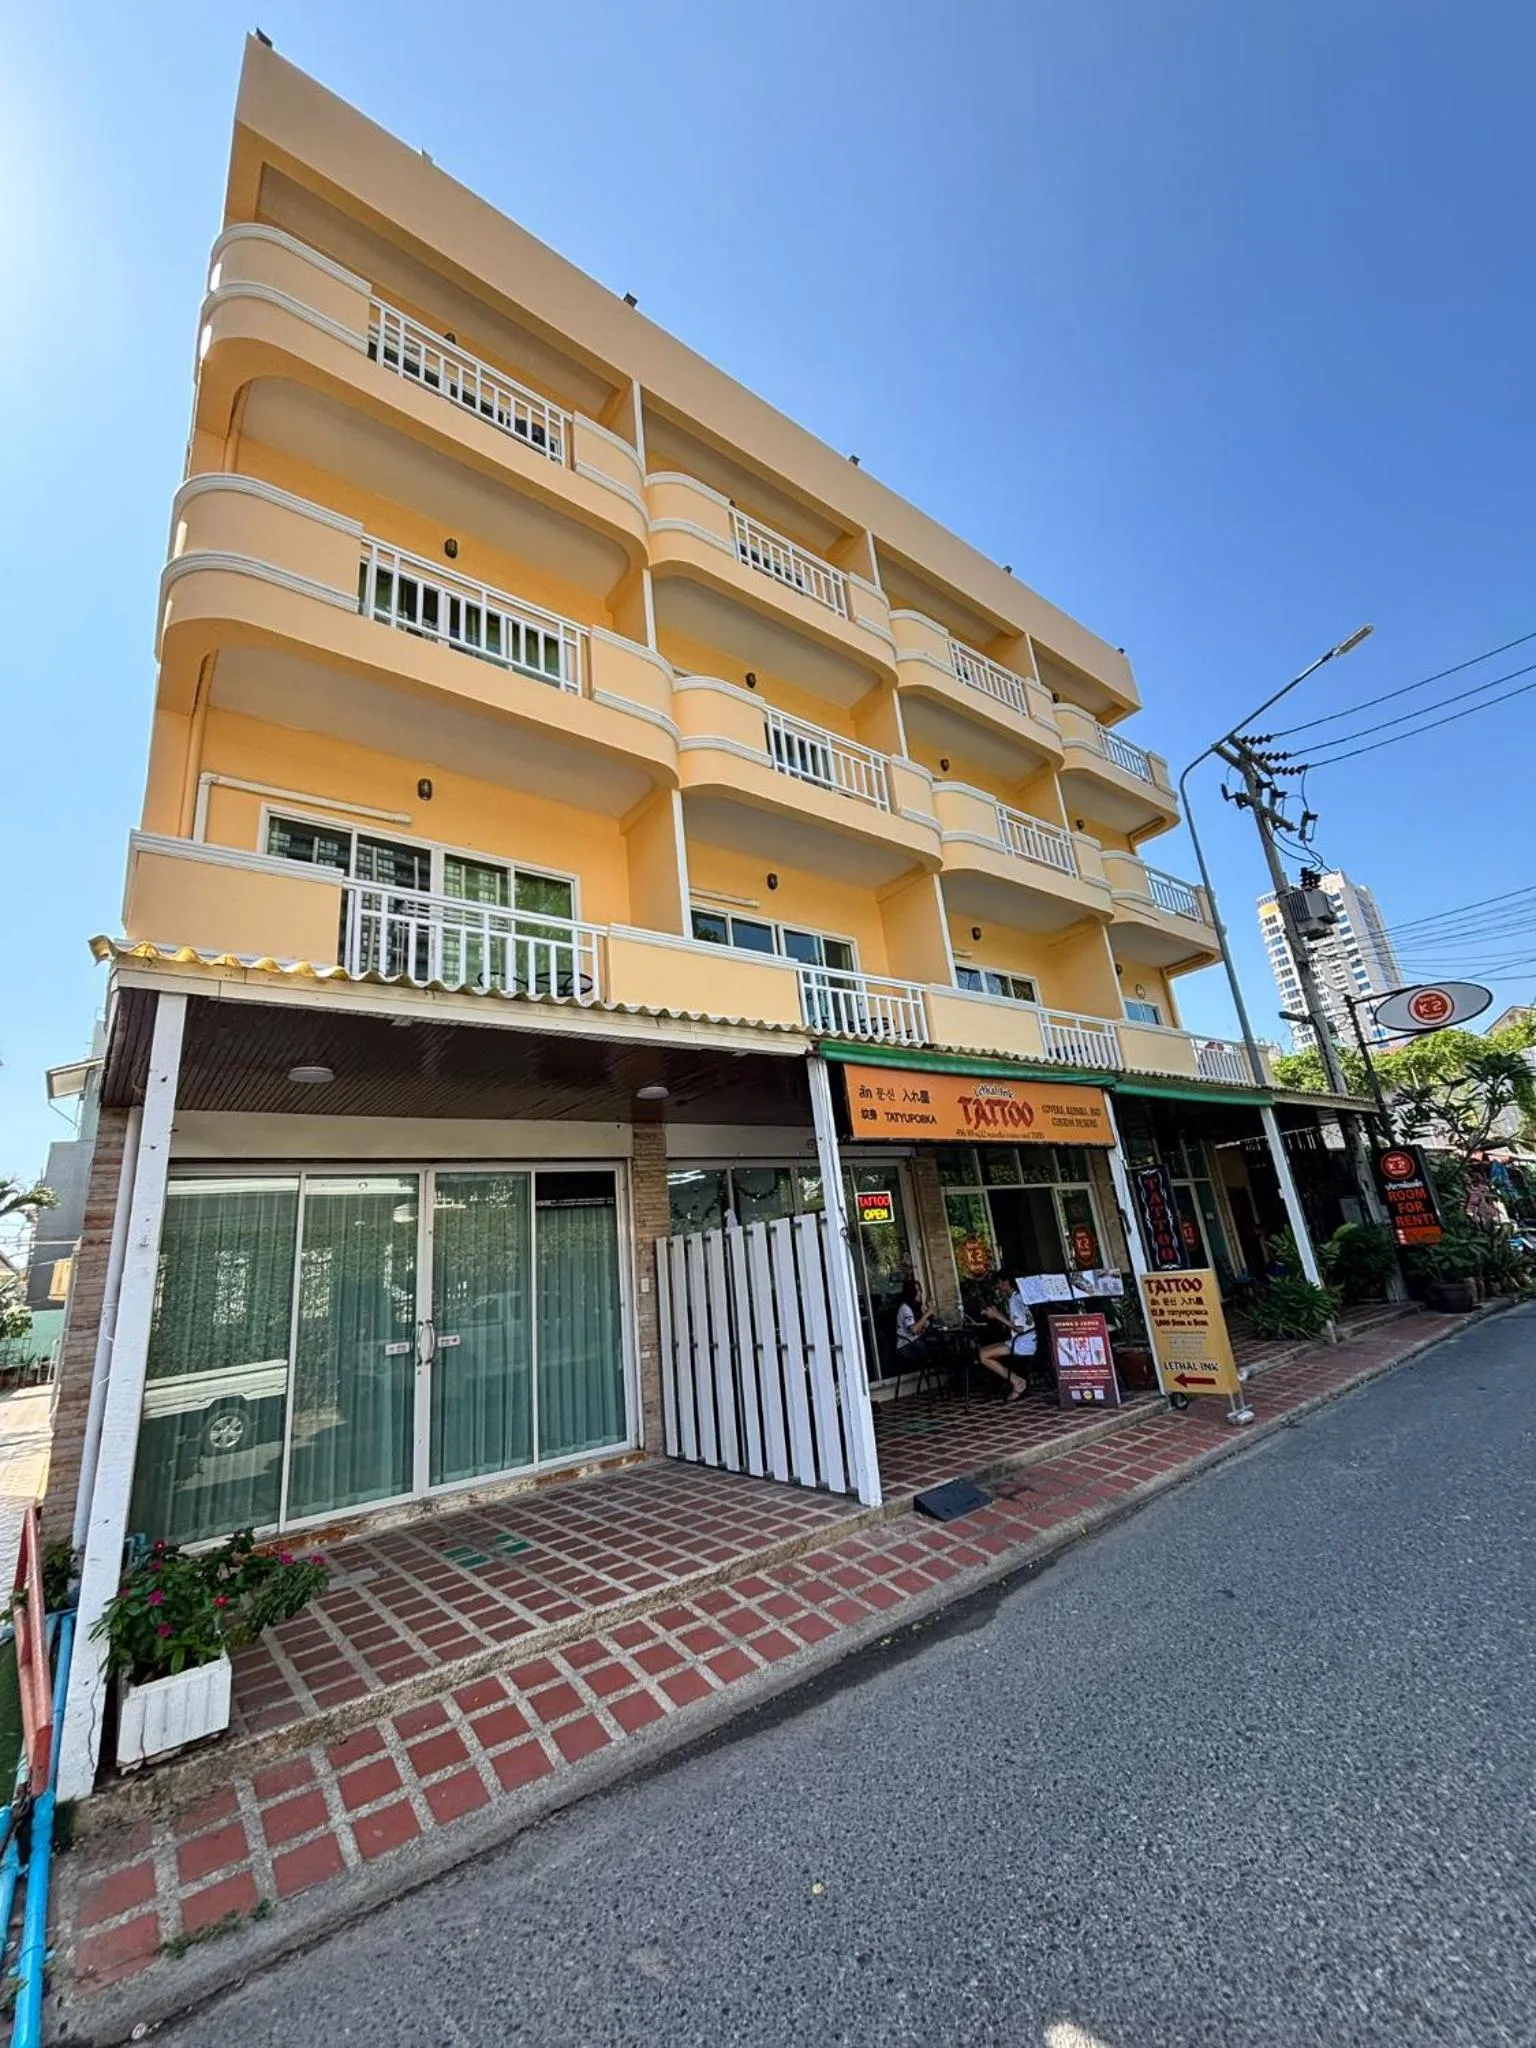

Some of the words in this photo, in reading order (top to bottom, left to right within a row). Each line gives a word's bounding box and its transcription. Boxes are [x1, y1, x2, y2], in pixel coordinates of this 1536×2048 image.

[957, 1096, 1034, 1130] TATTOO
[858, 1195, 891, 1207] TATTOO
[1388, 1188, 1427, 1201] ROOM
[1398, 1201, 1423, 1213] FOR
[863, 1208, 889, 1221] OPEN
[1144, 1278, 1203, 1296] TATTOO
[1164, 1361, 1198, 1371] LETHAL
[1201, 1362, 1219, 1371] INK
